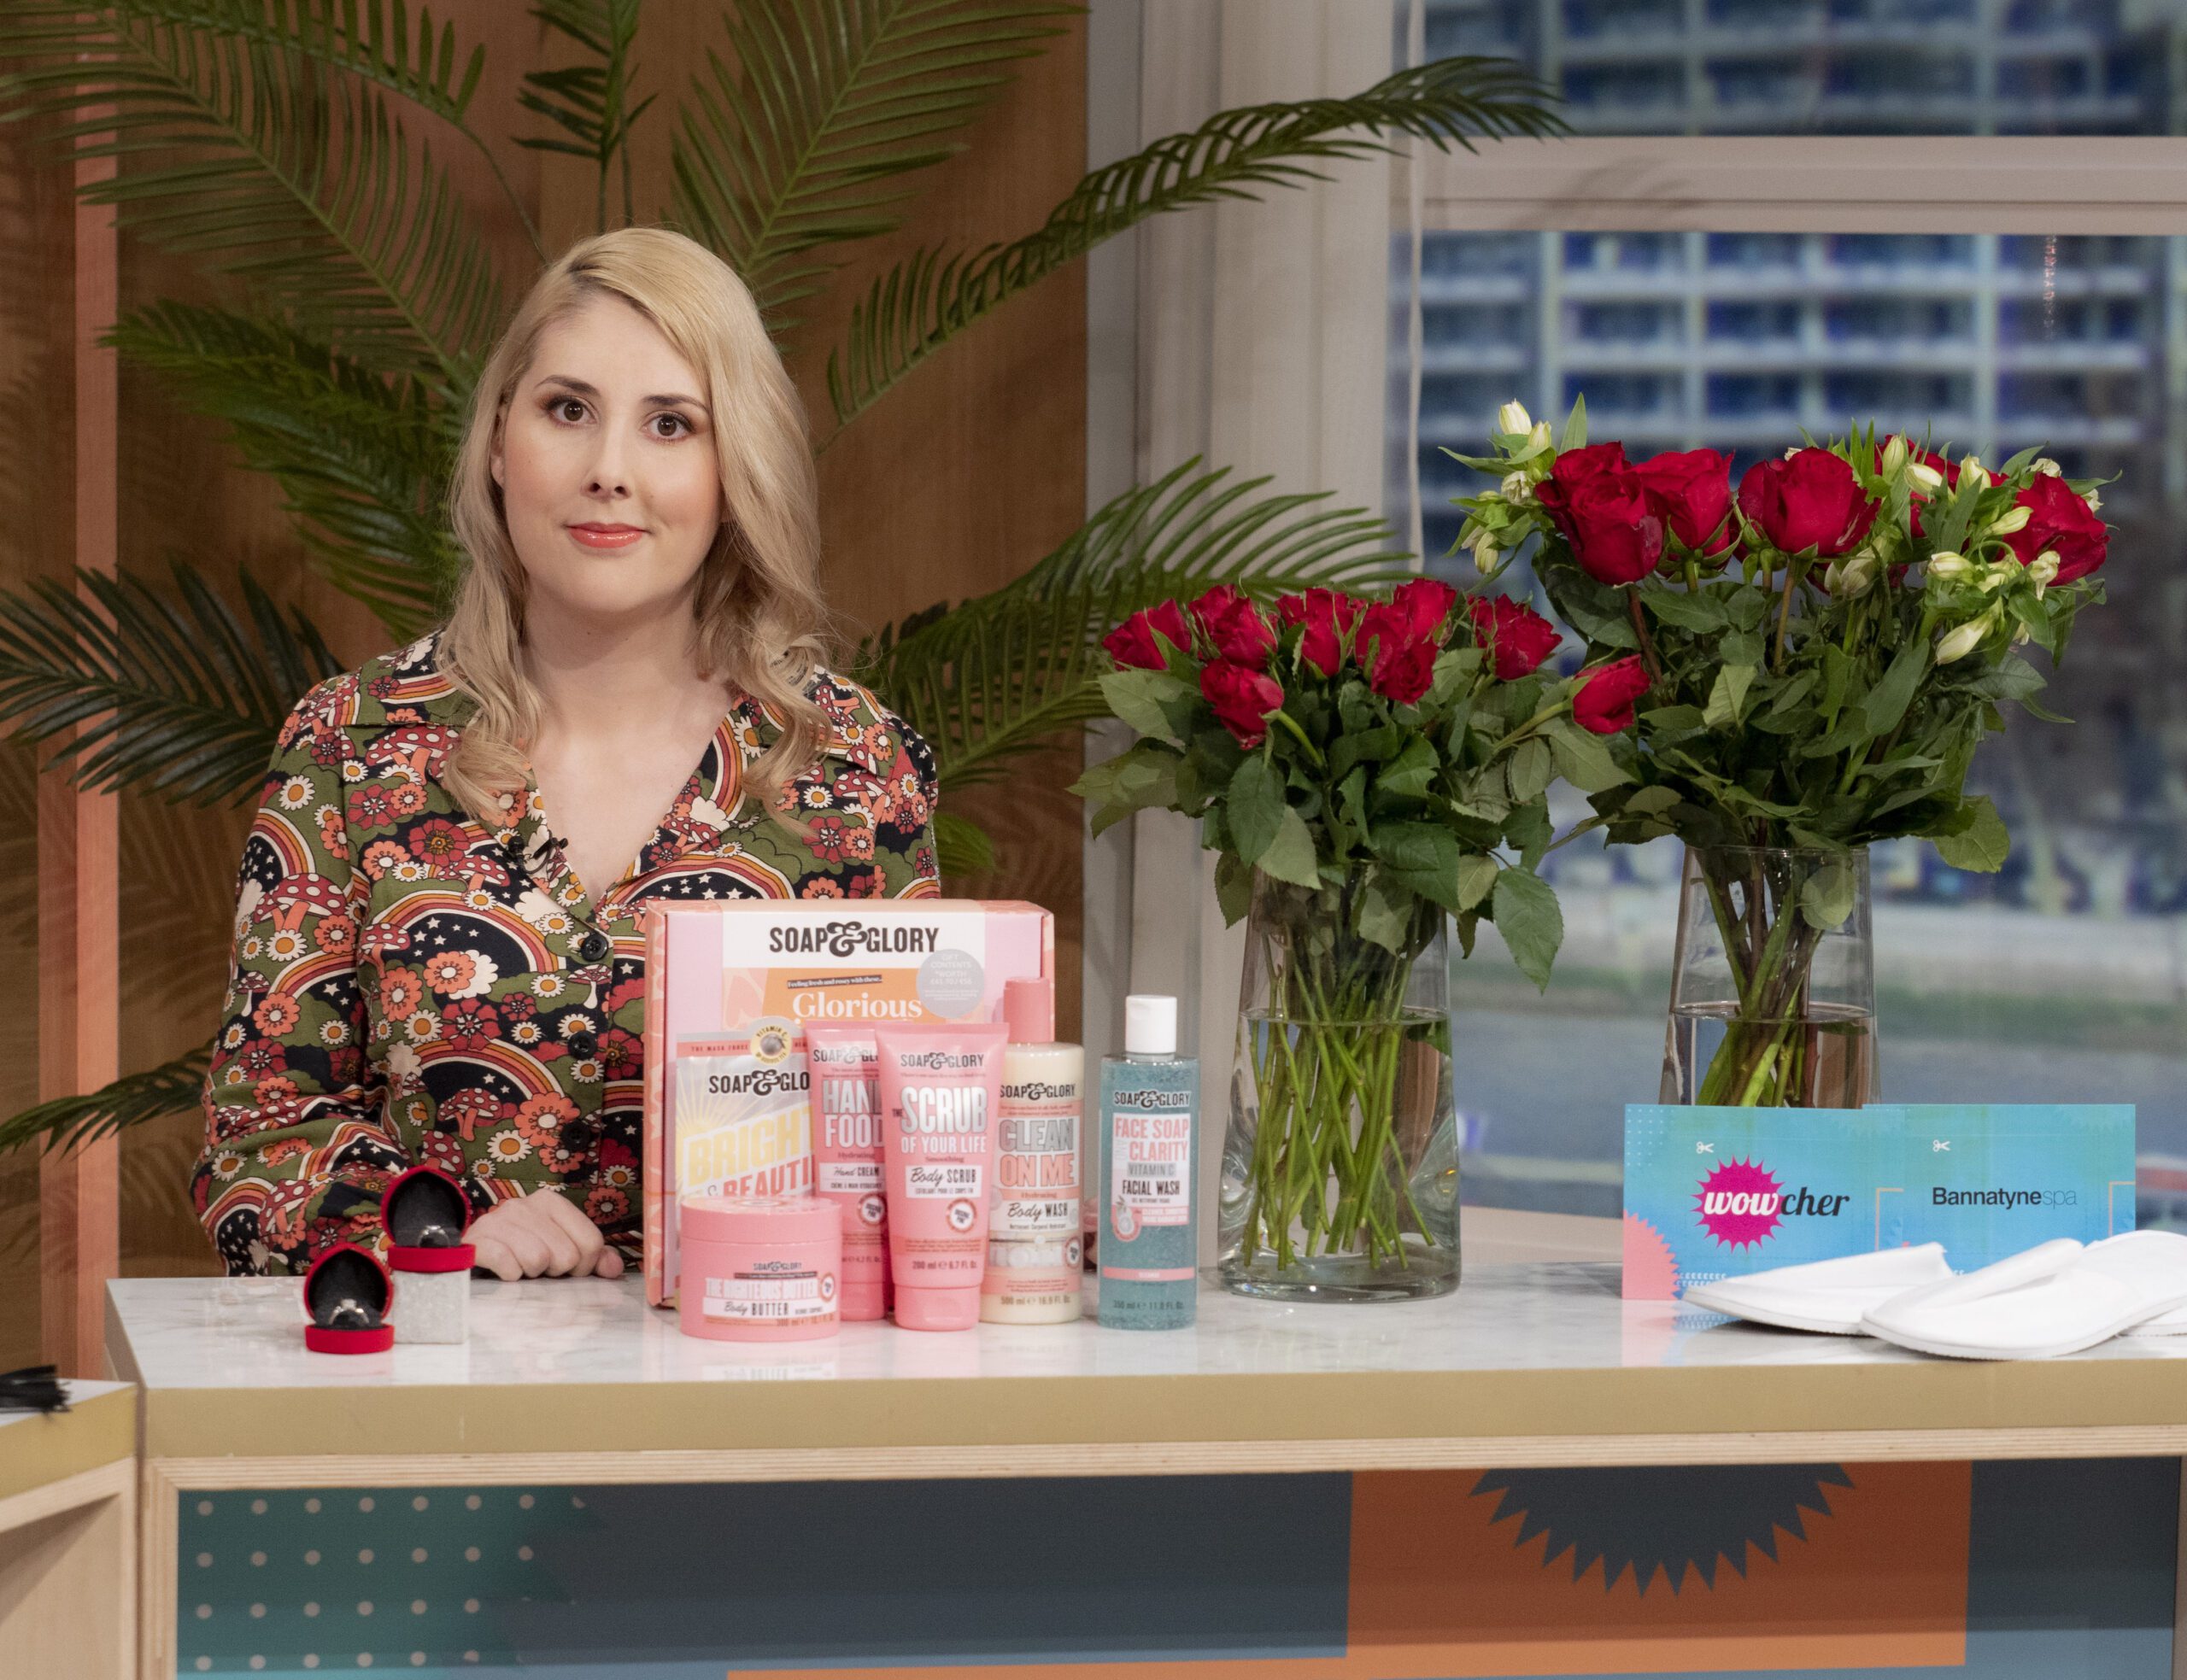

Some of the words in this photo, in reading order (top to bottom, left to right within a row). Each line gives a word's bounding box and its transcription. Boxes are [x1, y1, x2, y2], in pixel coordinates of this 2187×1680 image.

[770, 922, 939, 957] SOAP&GLORY
[793, 992, 923, 1018] Glorious
[756, 1026, 782, 1038] VITAMIN
[900, 1051, 984, 1070] SOAP&GLORY
[1000, 1083, 1076, 1100] SOAP&GLORY
[1114, 1091, 1190, 1108] SOAP&GLORY
[900, 1086, 988, 1133] SCRUB
[999, 1119, 1074, 1152] CLEAN
[1114, 1118, 1148, 1139] FACE
[1152, 1119, 1188, 1139] SOAP
[901, 1137, 917, 1153] OF
[921, 1137, 957, 1153] YOUR
[960, 1137, 987, 1154] LIFE
[1129, 1141, 1188, 1162] CLARITY
[834, 1167, 856, 1176] Hand
[857, 1167, 880, 1176] CREAM
[910, 1167, 943, 1187] Body
[947, 1168, 976, 1183] SCRUB
[1000, 1154, 1036, 1187] ON
[1041, 1153, 1075, 1186] ME
[1128, 1163, 1165, 1176] VITAMIN
[1168, 1163, 1176, 1176] C
[1123, 1180, 1151, 1195] FACIAL
[1156, 1180, 1180, 1195] WASH
[1703, 1186, 1850, 1216] wowcher
[1008, 1202, 1042, 1222] Body
[1045, 1203, 1068, 1217] WASH
[724, 1302, 748, 1315] Body
[752, 1302, 789, 1315] BUTTER
